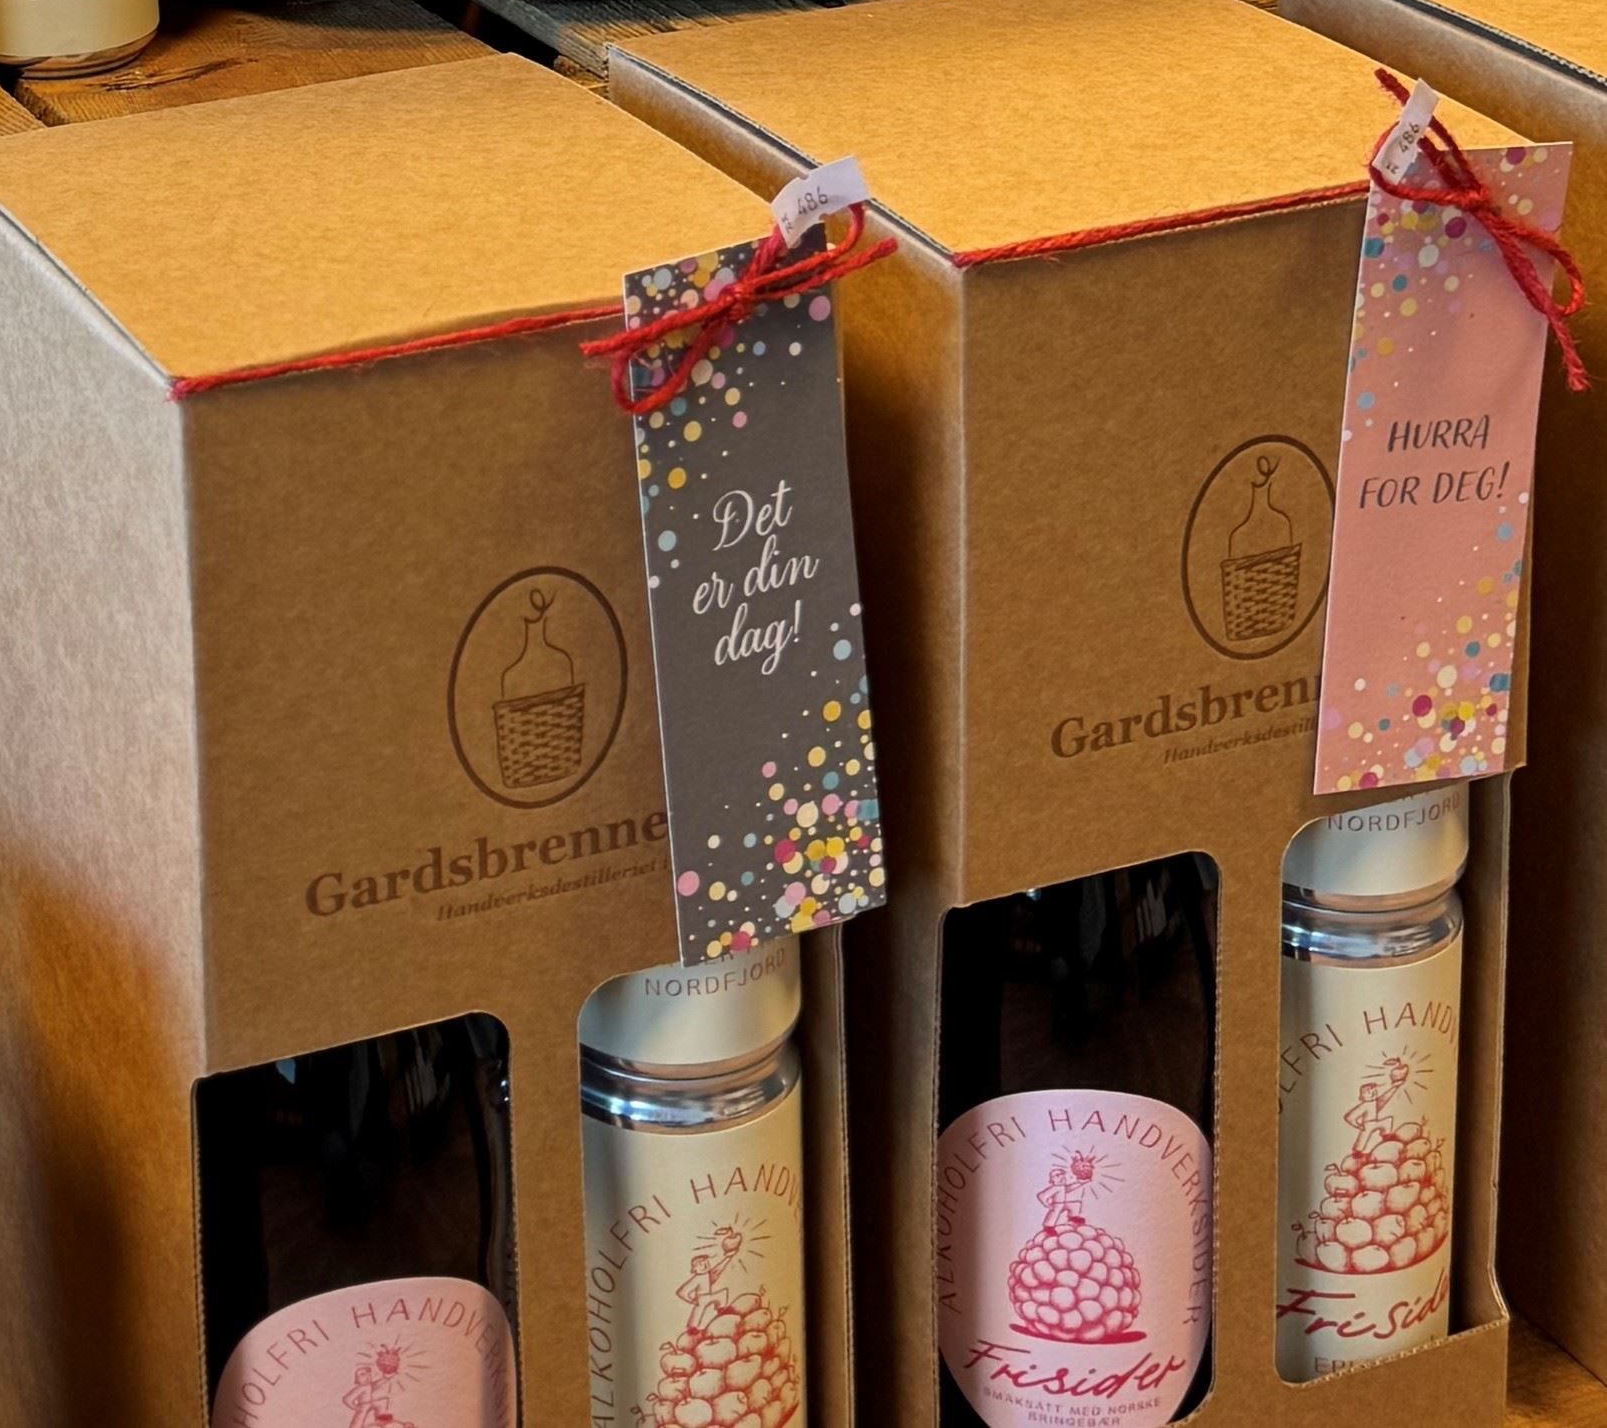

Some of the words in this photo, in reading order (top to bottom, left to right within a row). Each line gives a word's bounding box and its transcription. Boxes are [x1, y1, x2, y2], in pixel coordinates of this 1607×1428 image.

[797, 185, 828, 216] 486
[1387, 413, 1492, 454] HURRA
[1358, 469, 1420, 510] FOR
[1432, 461, 1511, 505] DEG!
[712, 479, 794, 552] Det
[692, 573, 736, 616] er
[743, 536, 820, 599] din
[714, 600, 804, 676] dag!
[1326, 790, 1461, 833] NORDFJORD
[305, 811, 669, 918] Gardsbrenne
[644, 947, 786, 997] NORDFJORD
